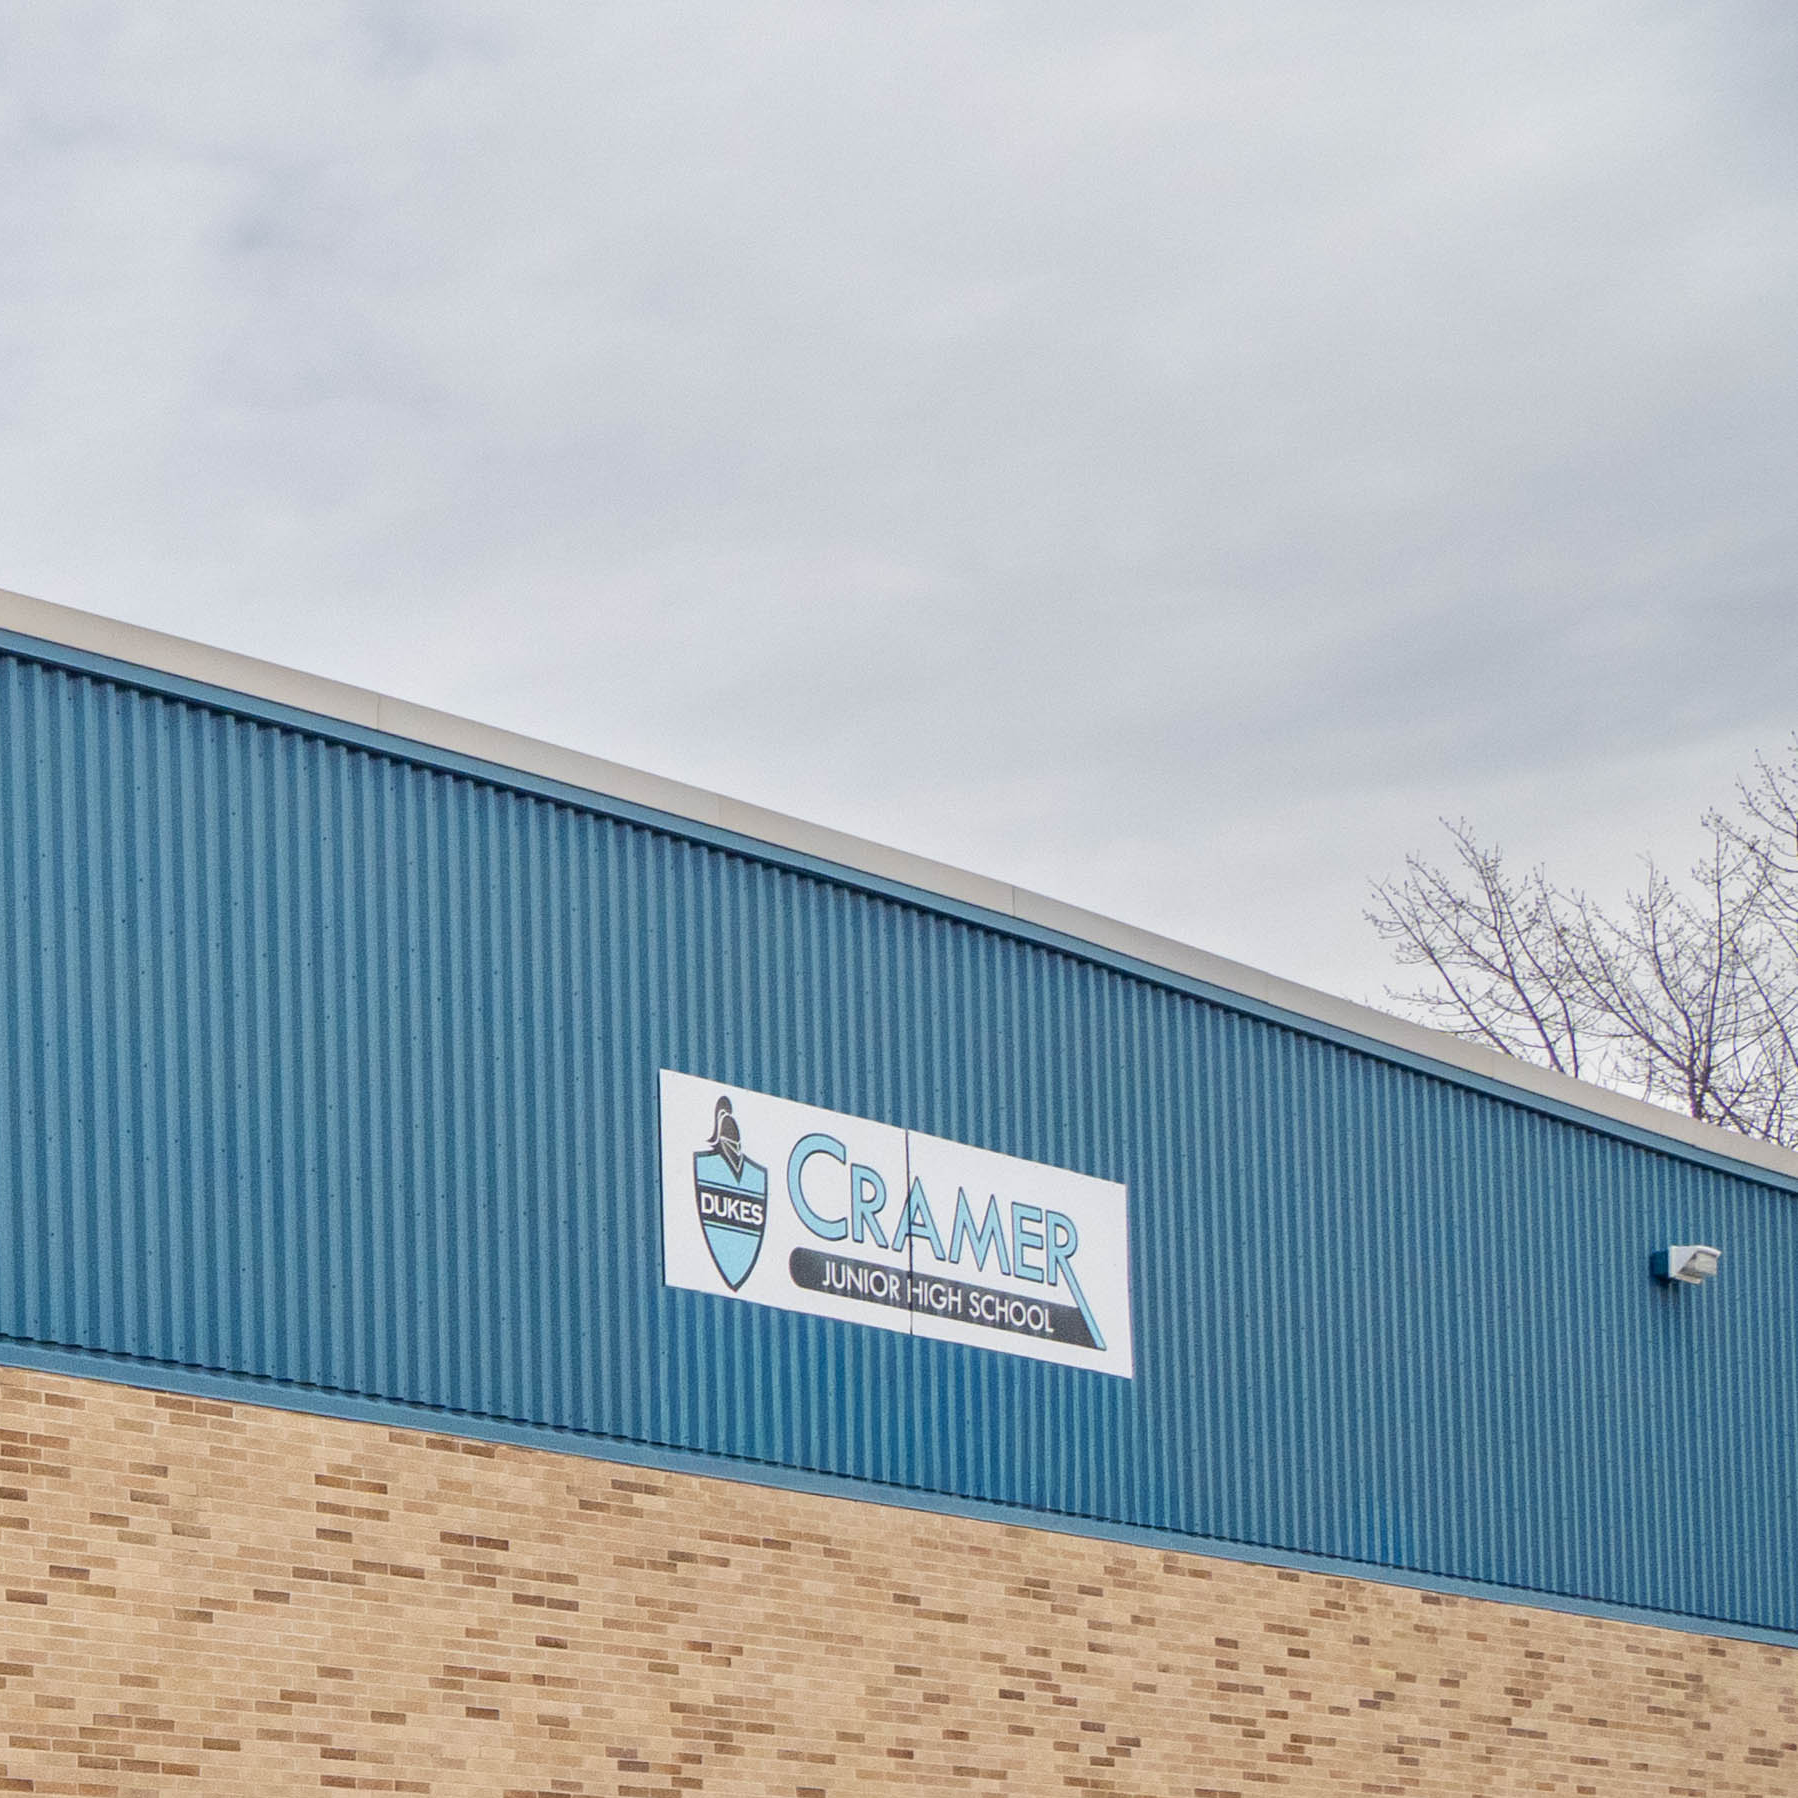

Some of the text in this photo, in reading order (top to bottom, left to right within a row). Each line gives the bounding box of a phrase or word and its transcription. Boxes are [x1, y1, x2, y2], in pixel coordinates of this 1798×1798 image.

[700, 1191, 763, 1226] DUKES
[787, 1133, 1106, 1350] CRAMER
[822, 1261, 1054, 1333] JUNIOR HIGH SCHOOL
